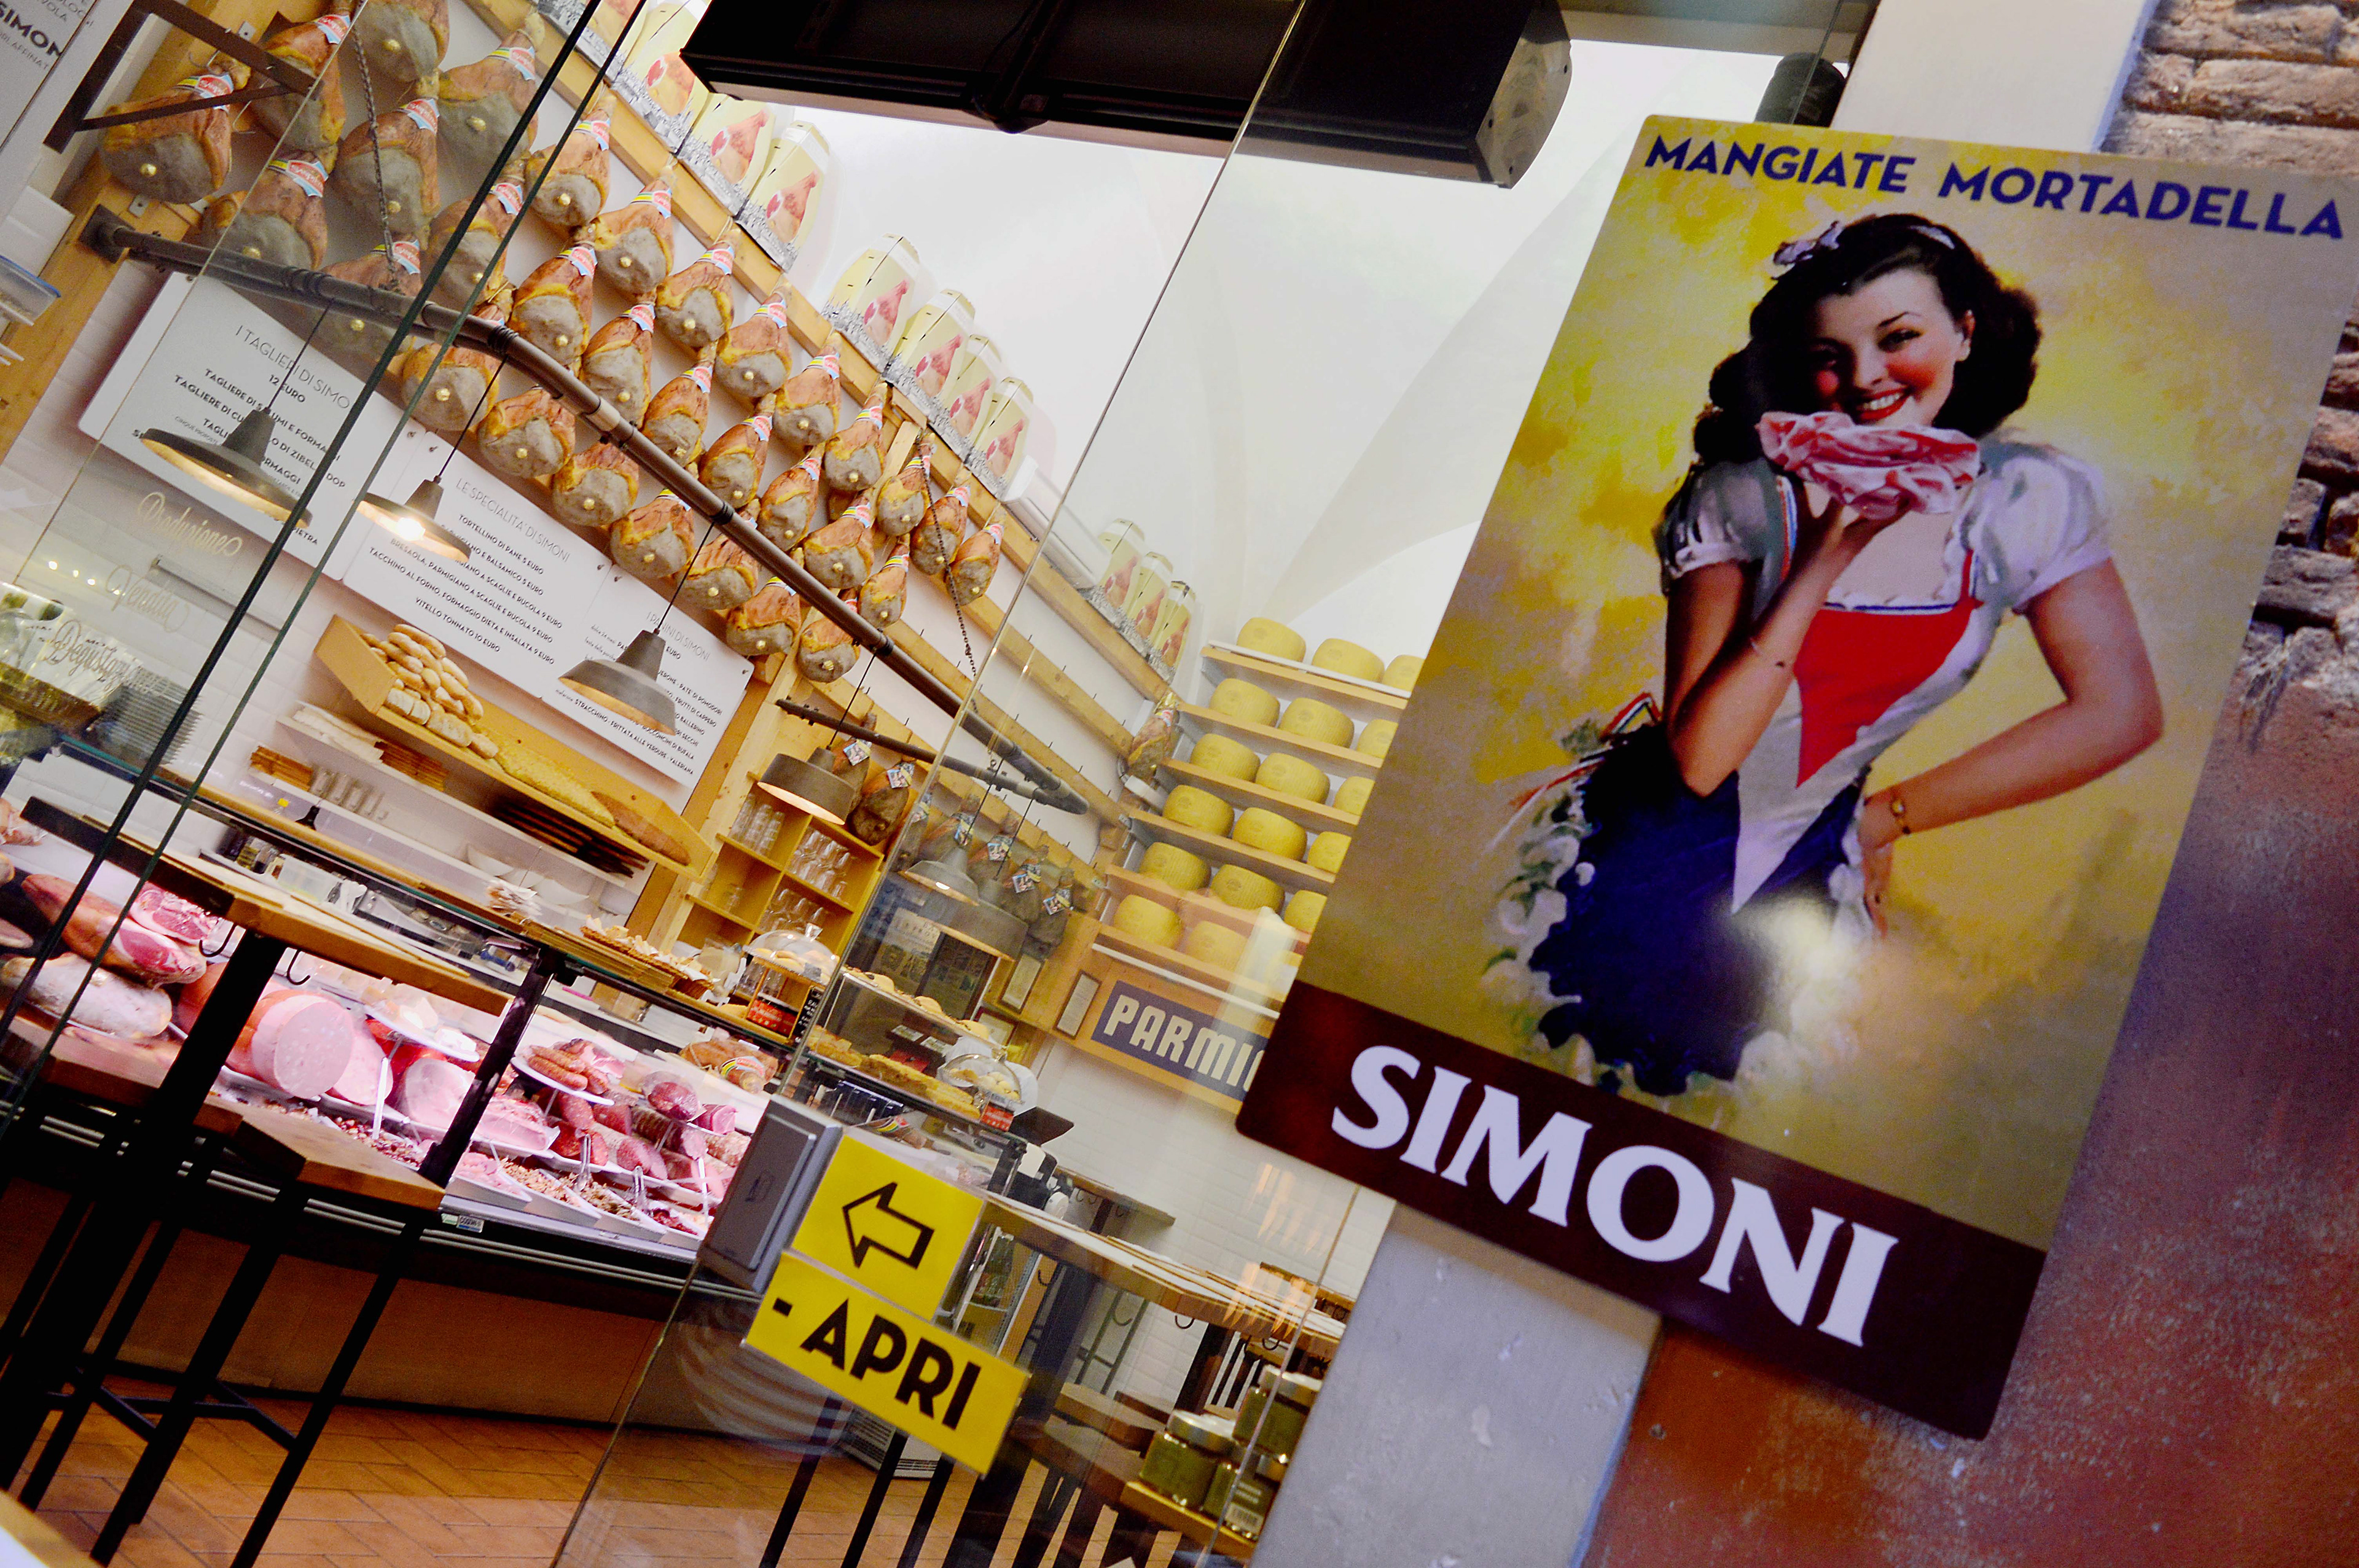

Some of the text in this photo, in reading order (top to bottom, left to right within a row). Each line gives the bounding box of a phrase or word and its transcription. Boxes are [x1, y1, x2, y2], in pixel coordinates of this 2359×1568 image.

[1644, 135, 2344, 240] MANGIATE MORTADELLA
[240, 329, 300, 376] TAGLIERI
[298, 369, 315, 386] DI
[312, 378, 353, 411] SIMO
[267, 374, 307, 404] 12 EURO
[203, 369, 247, 400] TAGLIERE
[245, 396, 257, 407] DI
[288, 423, 296, 432] E
[173, 375, 221, 409] TAGLIERE
[221, 404, 231, 415] DI
[279, 442, 291, 453] DI
[325, 472, 346, 489] DOP
[454, 478, 571, 563] LE SPECIALITA' DI SIMONI
[458, 513, 498, 544] TORTELLINO
[496, 540, 506, 550] DI
[504, 545, 522, 560] PANE
[526, 560, 544, 575] EURO
[389, 537, 429, 566] BRESAOLA,
[428, 561, 471, 591] PARMIGIANO
[475, 590, 503, 612] SCAGLIE
[506, 610, 532, 631] RUCOLA
[535, 628, 554, 644] EURO
[485, 575, 513, 597] SCAGLIE
[516, 595, 542, 616] RUCOLA
[545, 614, 563, 630] EURO
[486, 554, 523, 582] BALSAMICO
[526, 581, 544, 596] EURO
[368, 547, 407, 574] TACCHINO
[405, 569, 417, 580] AL
[415, 575, 442, 596] FORNO,
[441, 591, 482, 620] FORMAGGIO
[480, 615, 500, 632] DIETA
[504, 630, 534, 652] INSALATA
[538, 651, 555, 665] EURO
[414, 597, 501, 653] VITELLO TONNATO 10 EURO
[649, 613, 677, 637] PANINI
[673, 631, 685, 643] DI
[681, 636, 711, 662] SIMONI
[665, 646, 682, 660] EURO
[674, 696, 692, 711] FRUTTI
[694, 710, 717, 728] CAPPERO
[679, 715, 705, 736] BALLERINO
[697, 695, 723, 716] POMODORI
[574, 698, 609, 723] STRACCHINO
[609, 720, 635, 738] FRITTATA
[633, 735, 646, 746] ALLE
[645, 742, 667, 759] VERDURE
[668, 757, 694, 775] VALERIANA
[676, 745, 695, 760] BUFALA
[681, 733, 698, 747] SECCHI
[1331, 1045, 1899, 1347] SIMONI
[800, 1298, 982, 1431] APRI
